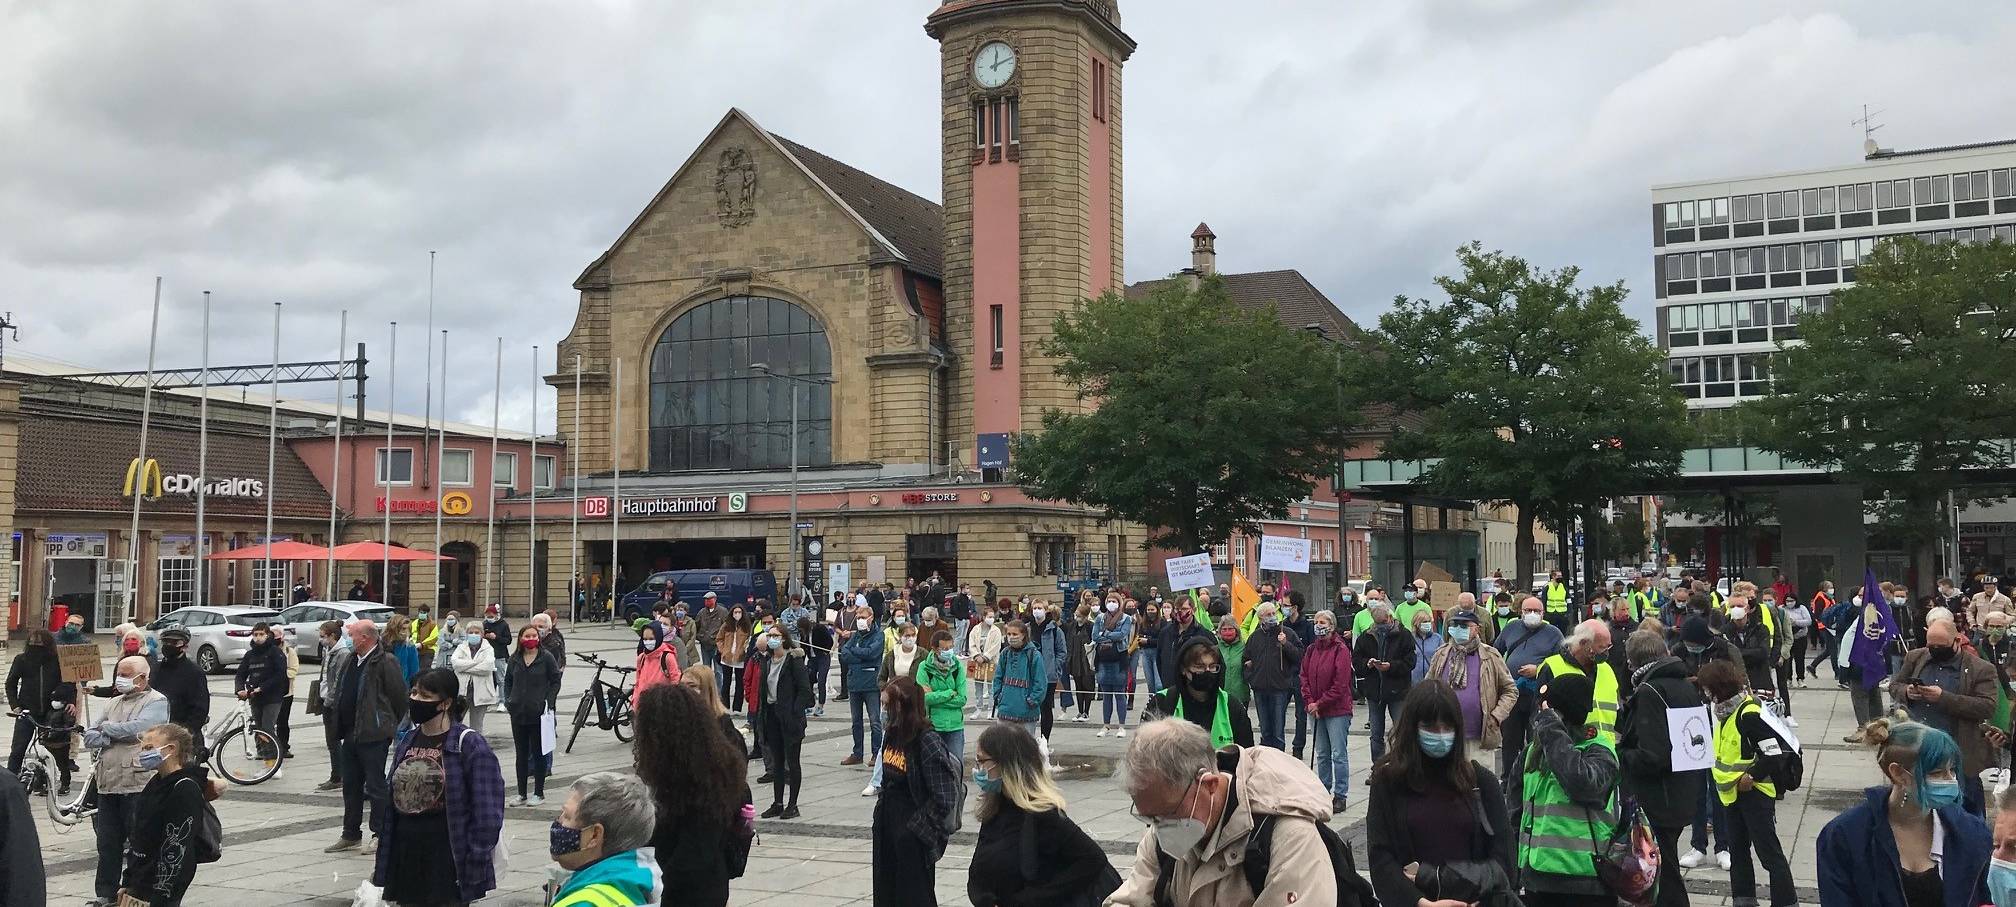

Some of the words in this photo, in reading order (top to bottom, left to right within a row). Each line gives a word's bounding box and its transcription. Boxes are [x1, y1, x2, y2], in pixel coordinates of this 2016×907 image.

[375, 496, 438, 516] Kamps
[621, 496, 717, 516] Hauptbahnhof
[925, 492, 957, 502] STORE
[587, 499, 606, 515] DB
